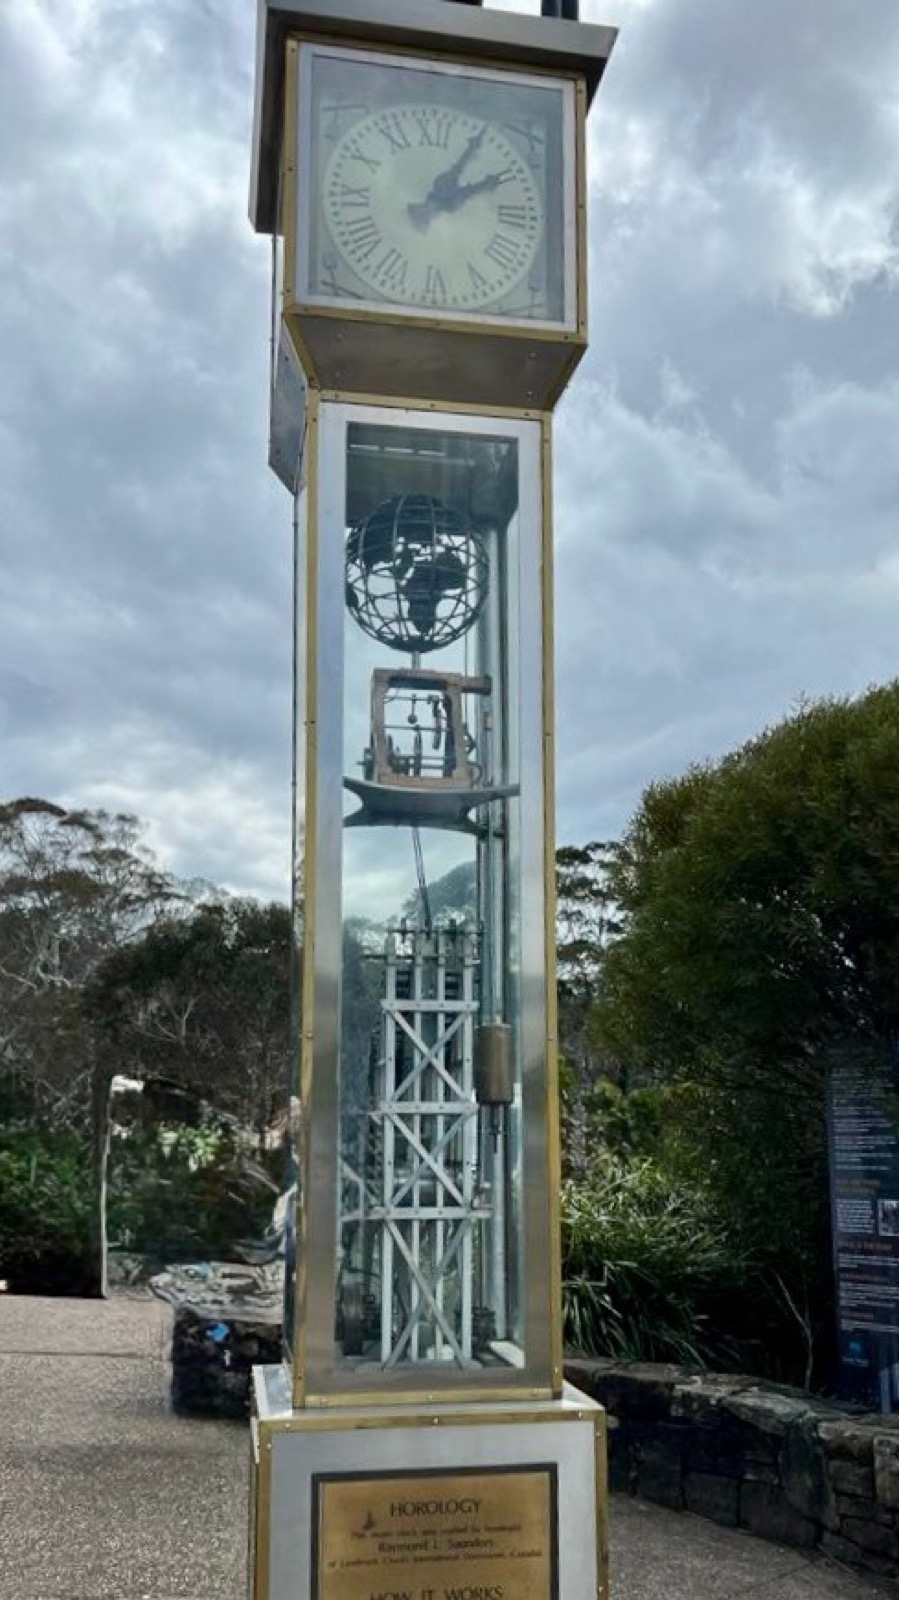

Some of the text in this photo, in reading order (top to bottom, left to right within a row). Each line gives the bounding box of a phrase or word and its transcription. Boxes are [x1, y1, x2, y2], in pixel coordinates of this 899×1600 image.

[378, 121, 411, 153] XI
[417, 118, 451, 148] XII
[350, 147, 382, 174] X
[340, 183, 370, 207] IX
[497, 204, 527, 230] III
[424, 264, 447, 295] VI
[466, 260, 489, 289] V
[390, 1499, 481, 1517] HOROLOGY
[370, 1584, 504, 1600] HOW IT WORKS
